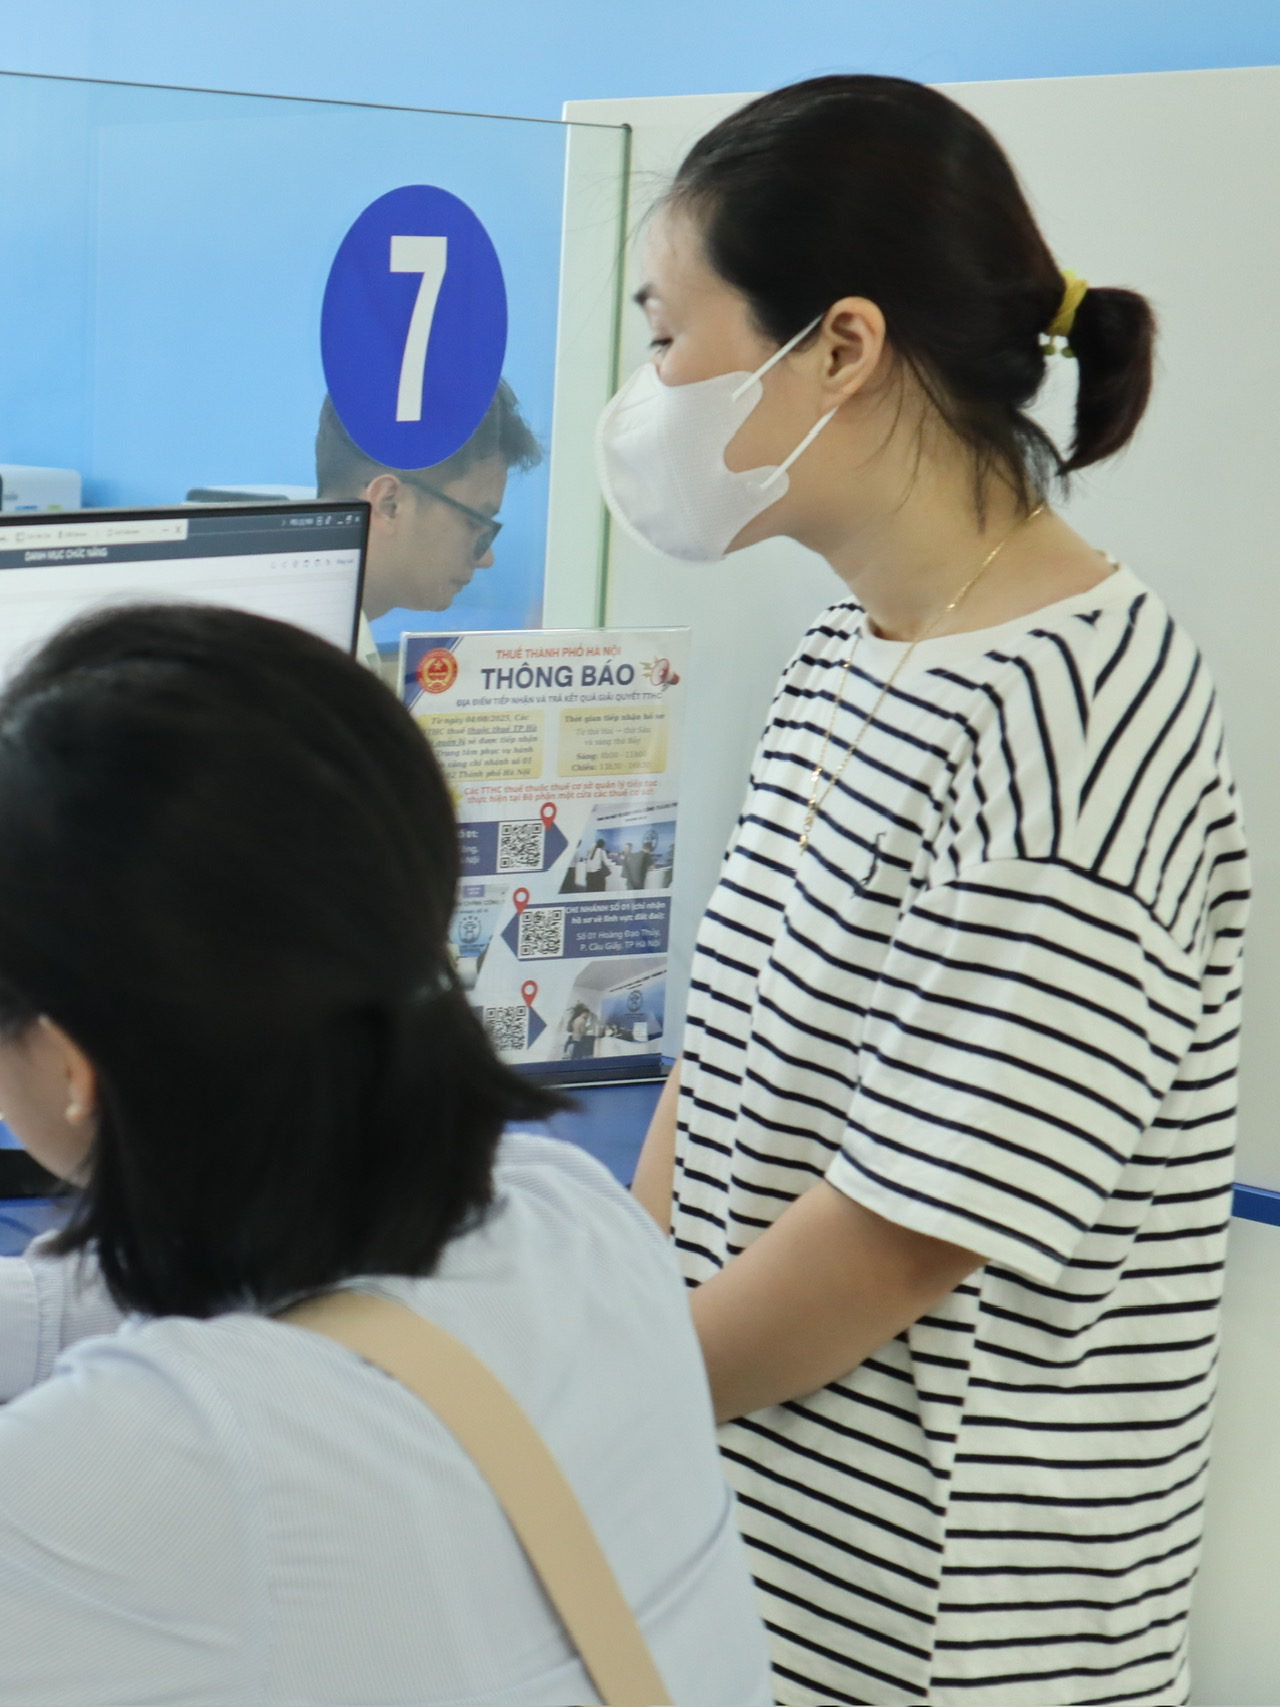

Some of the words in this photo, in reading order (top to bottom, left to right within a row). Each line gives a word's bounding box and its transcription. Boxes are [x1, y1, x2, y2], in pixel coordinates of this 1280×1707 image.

[390, 235, 447, 422] 7
[481, 662, 573, 690] THÔNG
[581, 659, 635, 687] BÁO
